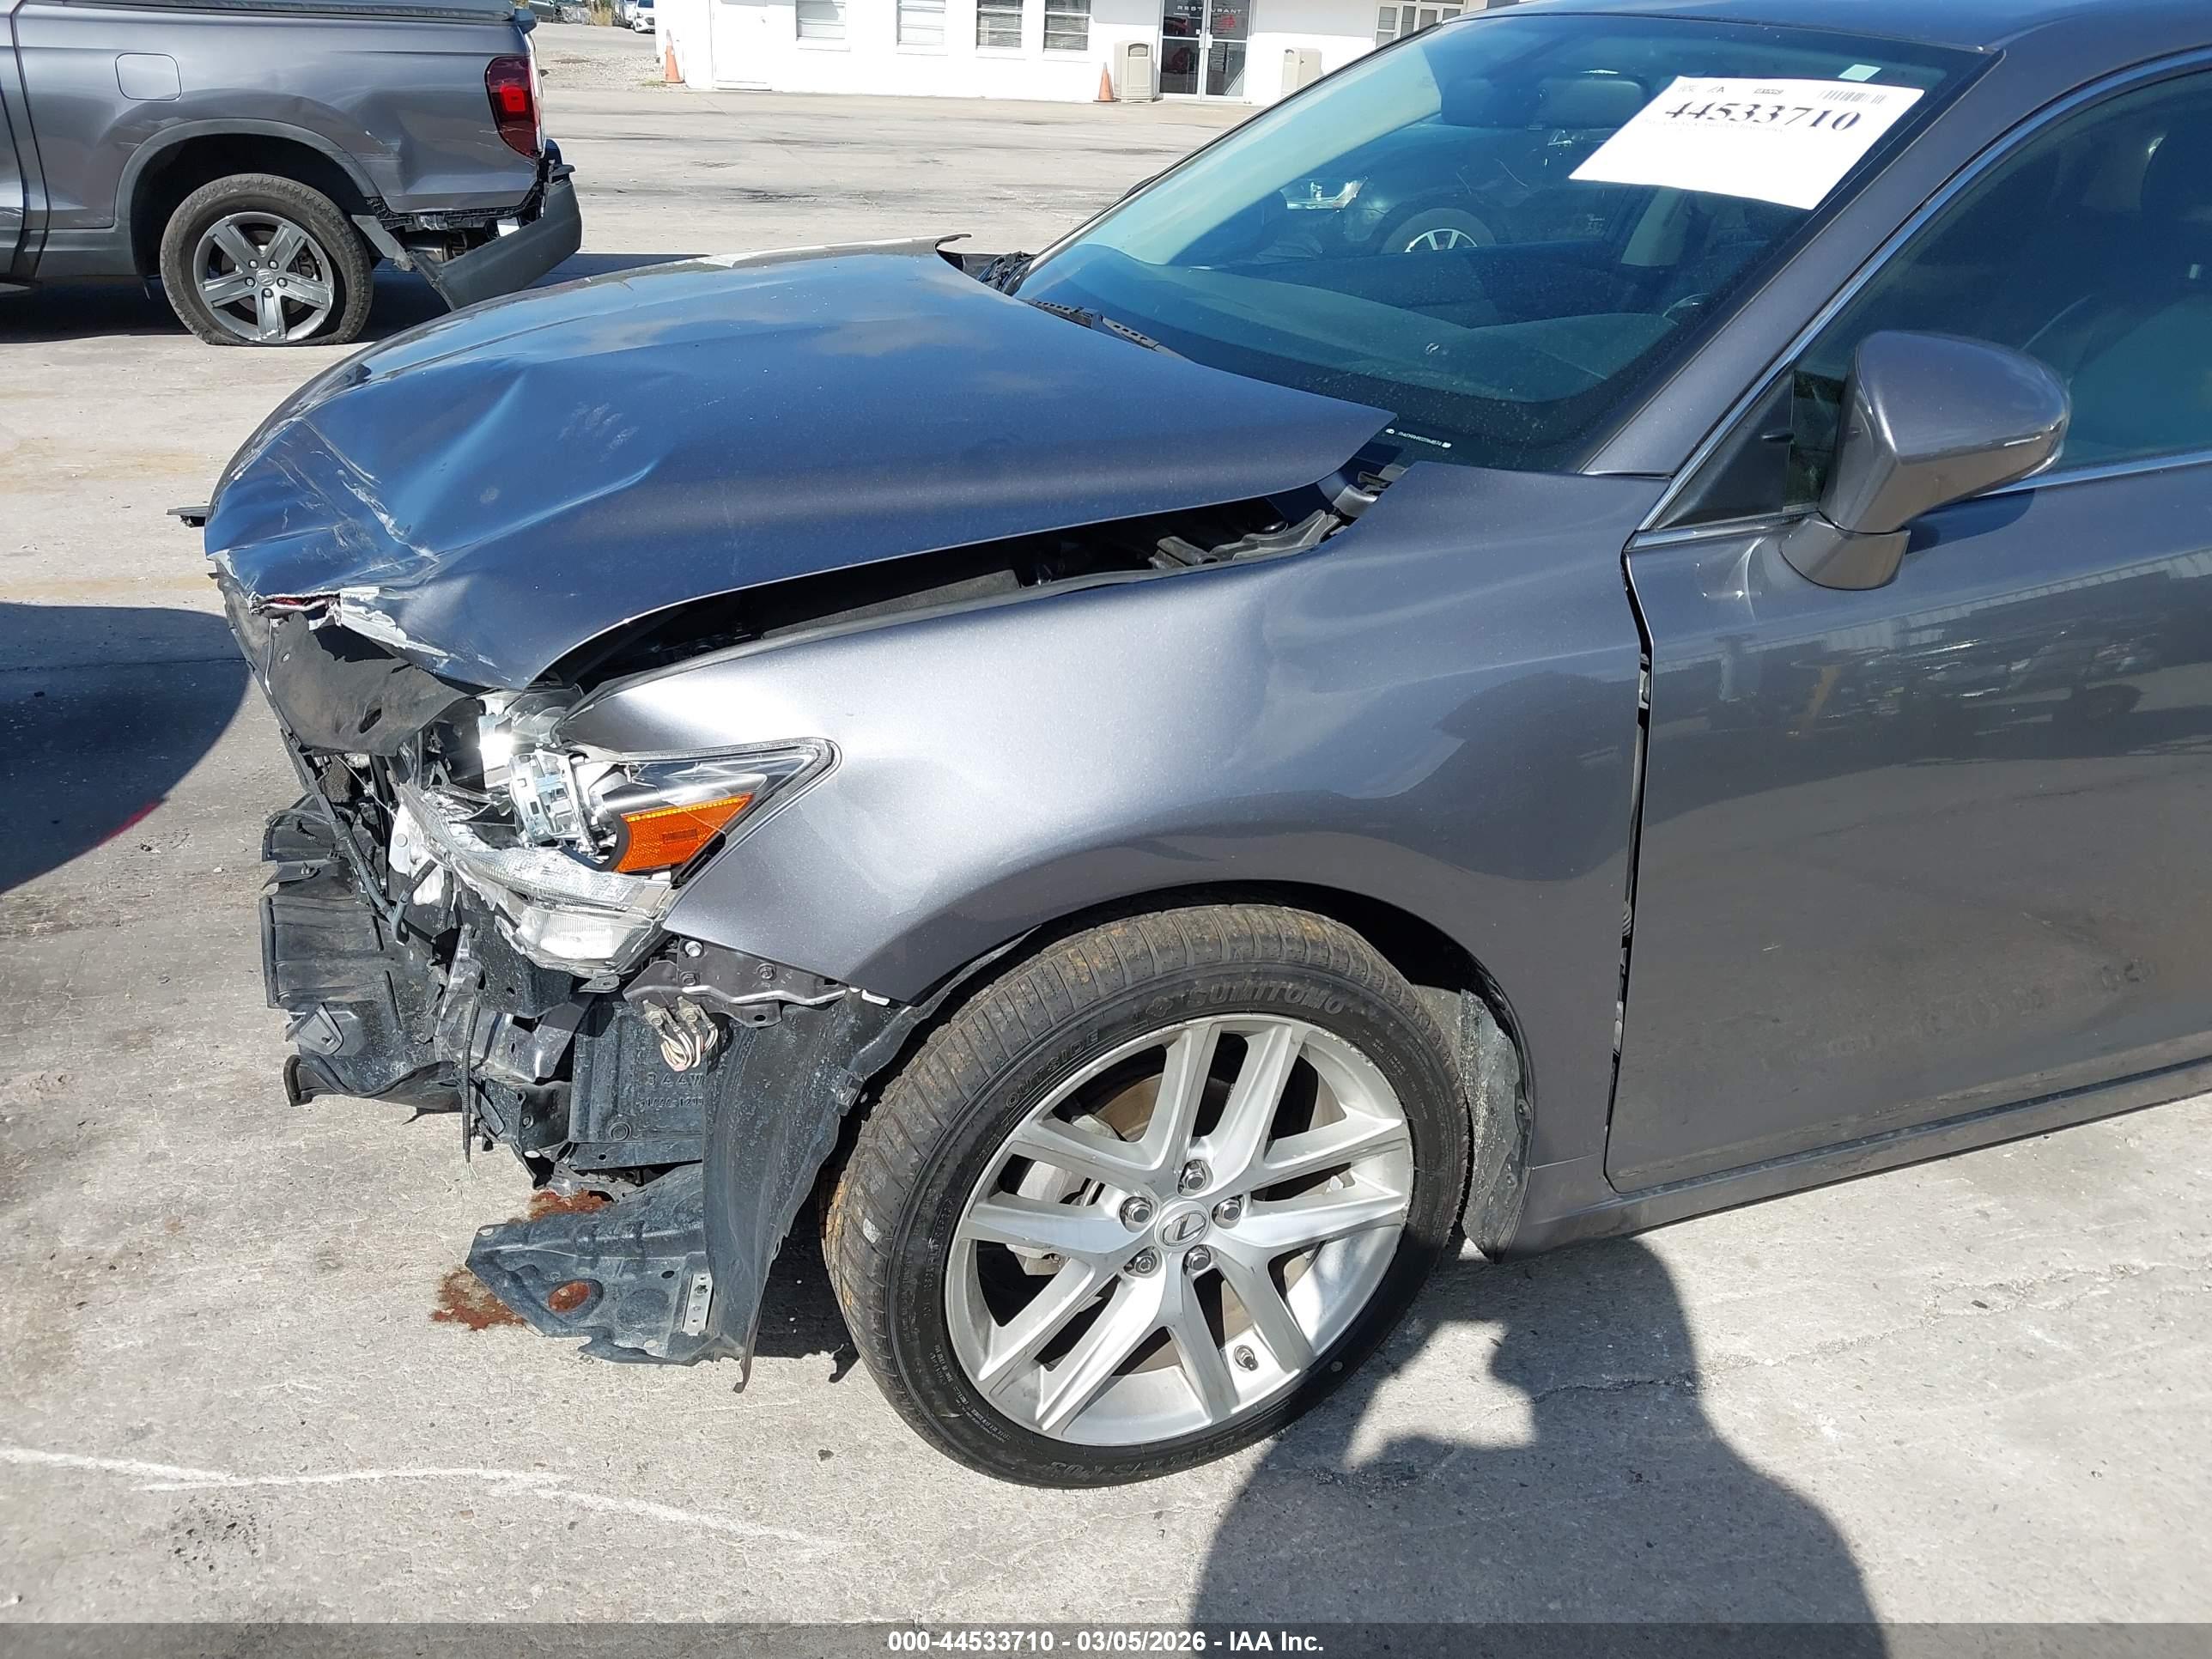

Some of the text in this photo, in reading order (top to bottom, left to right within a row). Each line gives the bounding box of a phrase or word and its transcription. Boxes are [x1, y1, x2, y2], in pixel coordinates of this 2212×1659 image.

[1177, 5, 1242, 15] RESTURANT
[1665, 101, 1861, 131] 44533710
[1187, 980, 1347, 1015] SUMITOMO
[1006, 1030, 1099, 1108] OUTSIDE
